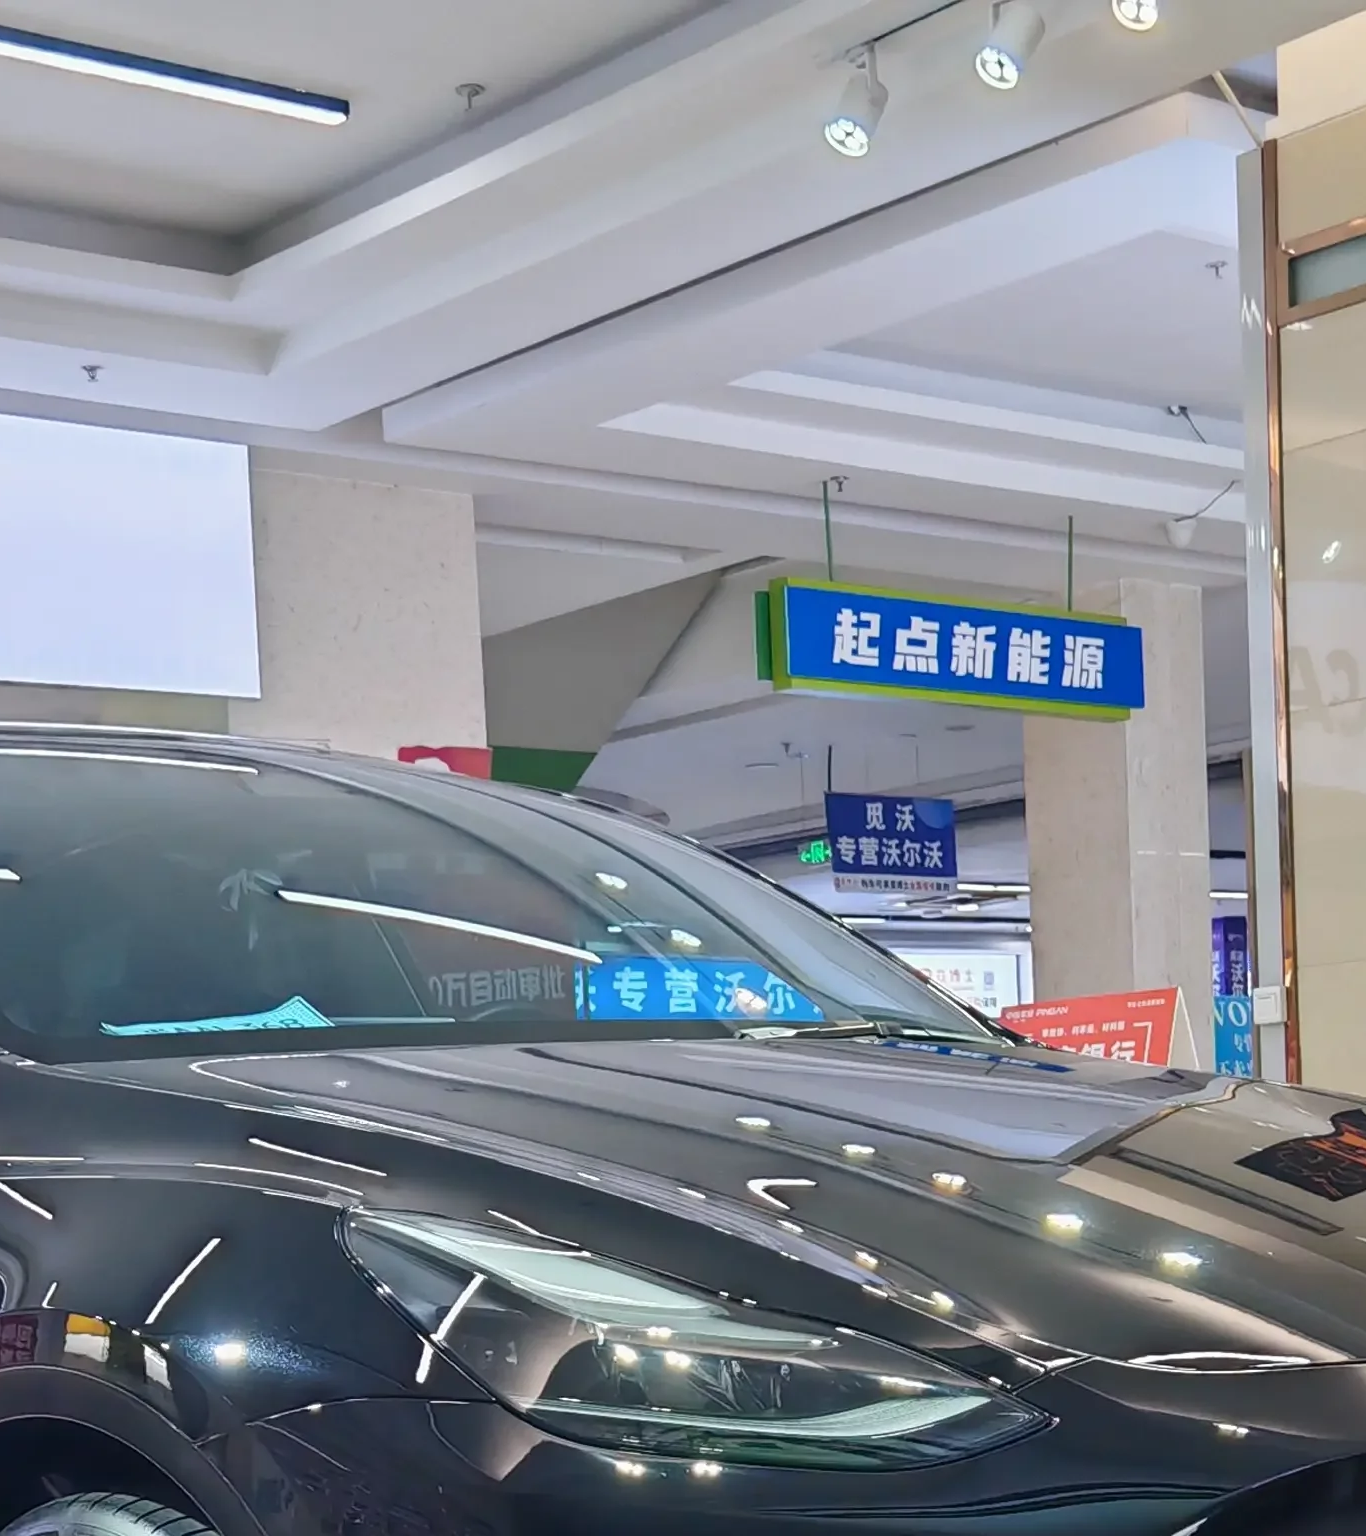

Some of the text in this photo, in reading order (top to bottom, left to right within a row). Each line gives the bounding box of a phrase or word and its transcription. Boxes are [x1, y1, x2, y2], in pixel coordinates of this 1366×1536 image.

[832, 607, 1106, 690] 起点新能源
[836, 835, 944, 869] 专营沃尔沃
[574, 966, 822, 1015] 专营沃尔
